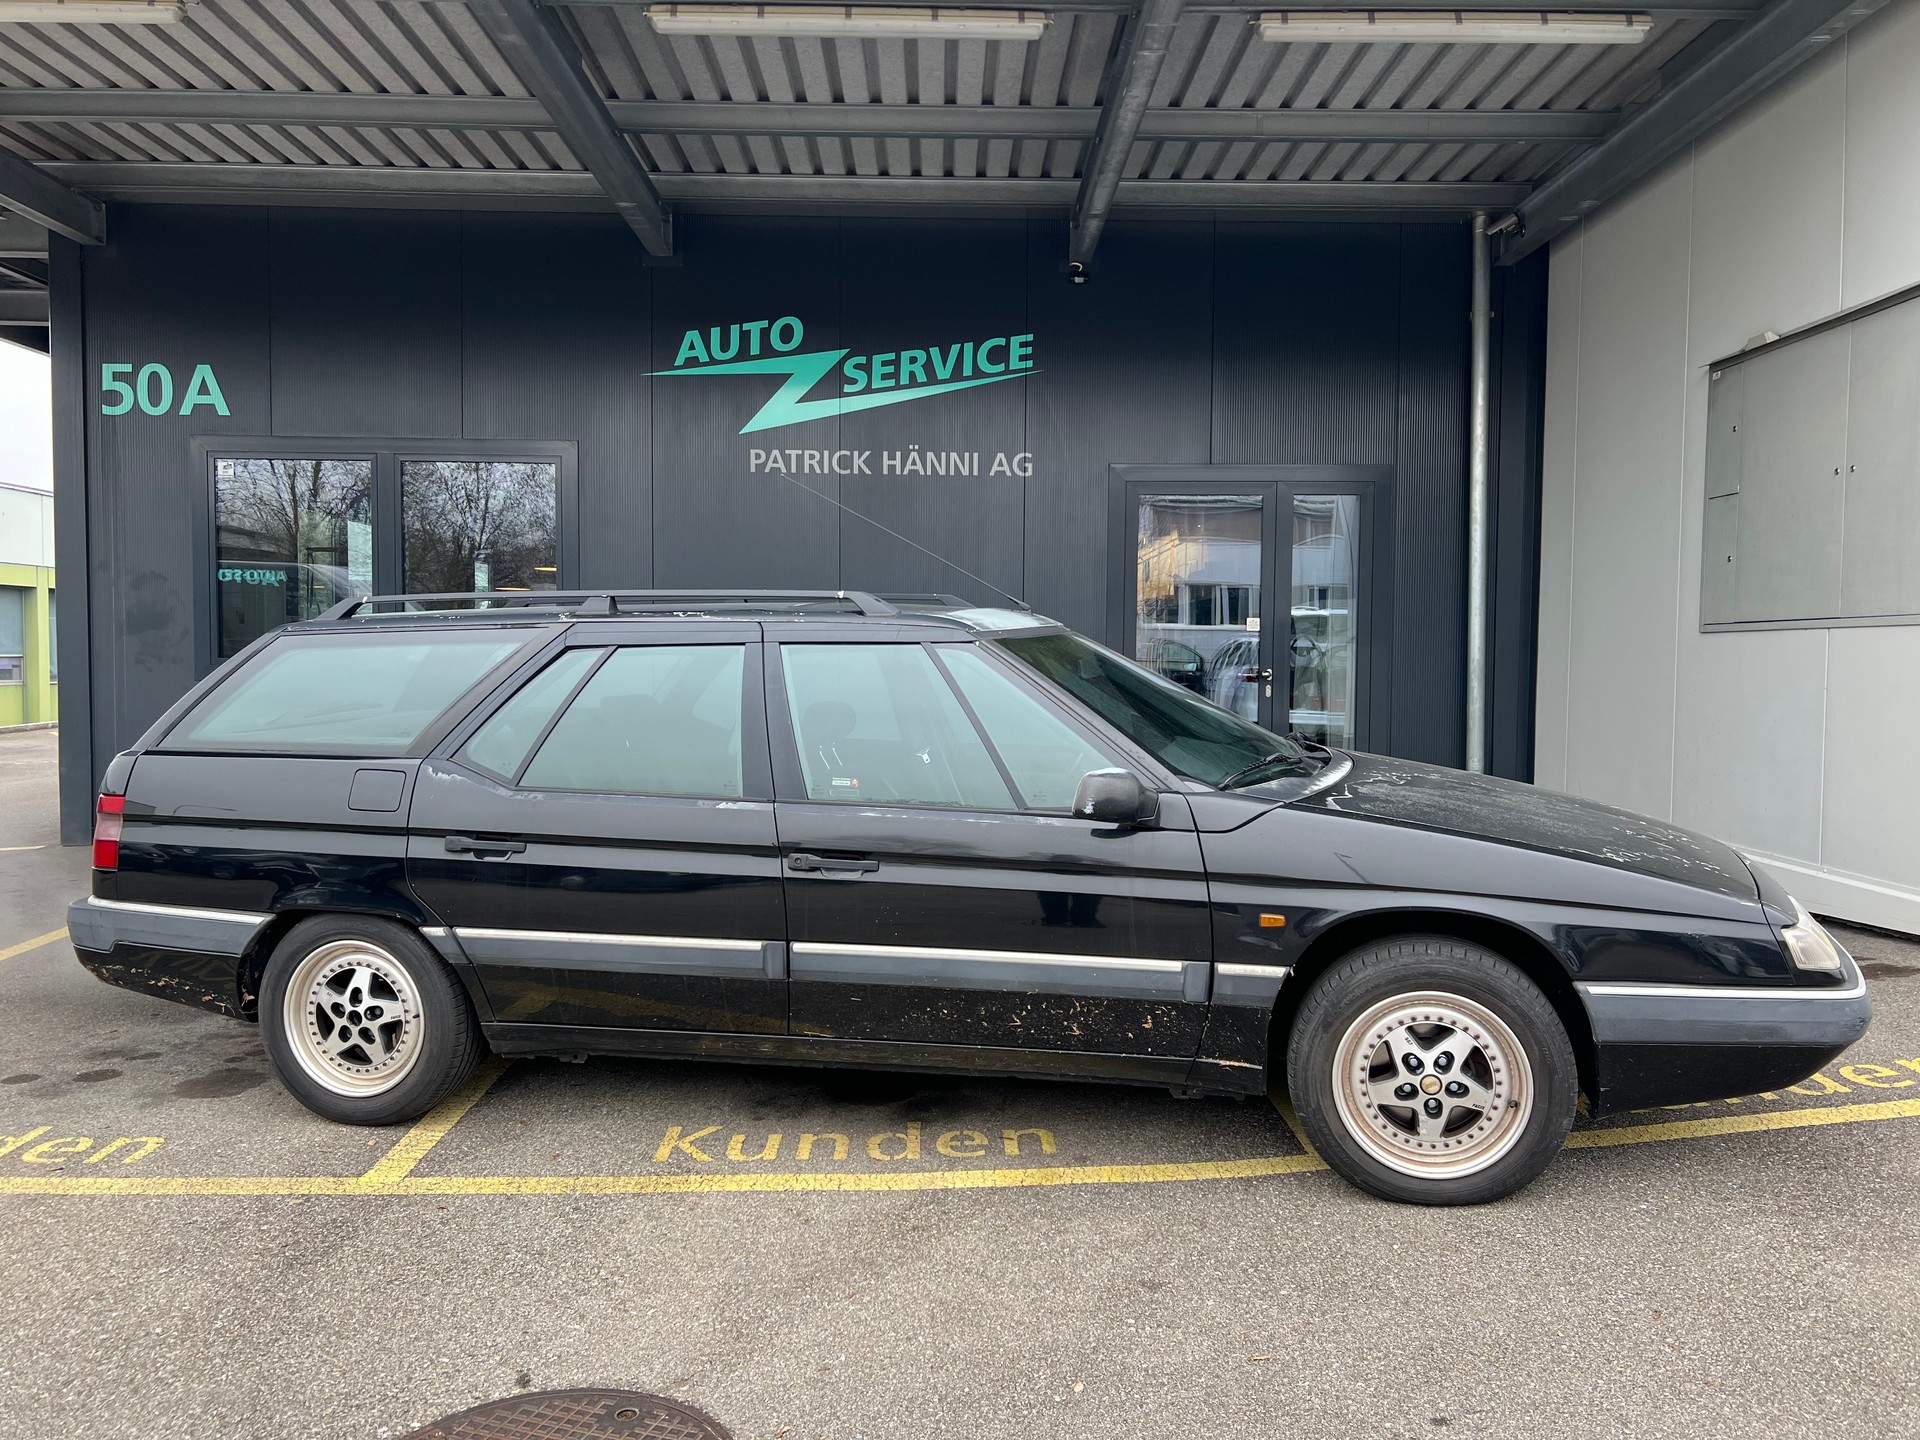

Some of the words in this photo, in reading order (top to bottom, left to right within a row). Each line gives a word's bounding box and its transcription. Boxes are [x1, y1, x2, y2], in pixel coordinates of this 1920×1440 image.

[675, 316, 804, 367] AUTO
[842, 333, 1035, 394] SERVICE
[748, 448, 873, 476] PATRICK
[882, 444, 979, 477] HÄNNI
[989, 448, 1034, 478] AG
[653, 1123, 1057, 1163] Kunden
